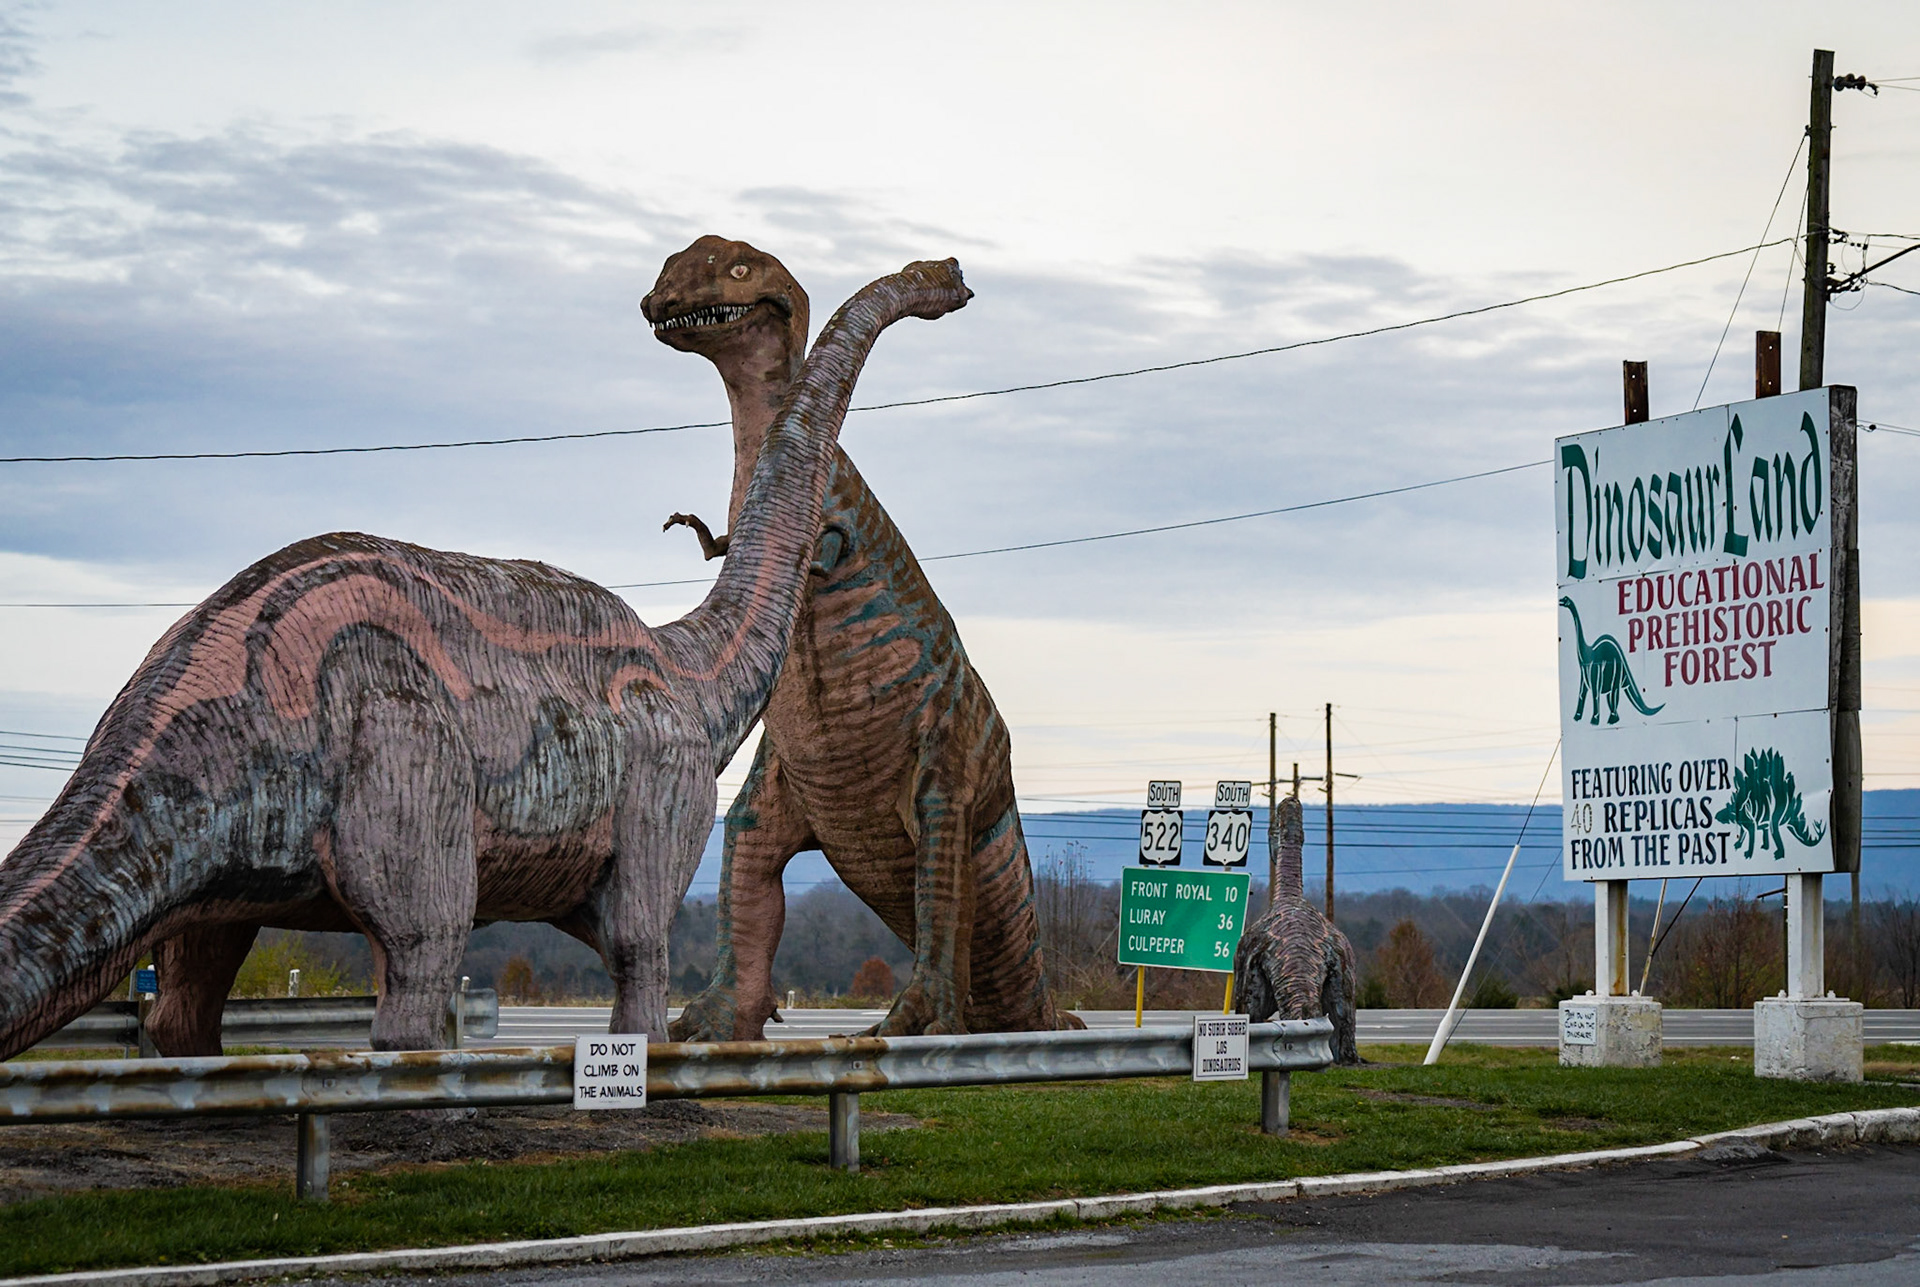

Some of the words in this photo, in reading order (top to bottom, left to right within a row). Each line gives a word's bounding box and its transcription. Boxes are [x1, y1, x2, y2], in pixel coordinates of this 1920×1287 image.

[1617, 552, 1825, 615] EDUCATIONAL
[1627, 595, 1812, 653] PREHISTORIC
[1664, 639, 1777, 687] FOREST
[1571, 762, 1672, 799] FEATURING
[1679, 758, 1731, 793] OVER
[1149, 784, 1179, 802] SOUTH
[1217, 784, 1249, 802] SOUTH
[1571, 802, 1593, 835] 40
[1603, 796, 1713, 833] REPLICAS
[1143, 822, 1179, 851] 522
[1207, 822, 1247, 853] 340
[1571, 836, 1625, 870] FROM
[1631, 833, 1671, 866] THE
[1678, 831, 1731, 865] PAST
[1131, 881, 1168, 898] FRONT
[1175, 883, 1213, 902] ROYAL
[1224, 886, 1238, 903] 10
[1129, 908, 1166, 925] LURAY
[1217, 913, 1233, 930] 36
[1128, 935, 1185, 954] CULPEPER
[1214, 941, 1230, 958] 56
[1198, 1023, 1206, 1036] NO
[1208, 1022, 1226, 1036] SUBIR
[1228, 1022, 1246, 1036] SOBRE
[590, 1043, 608, 1056] DO
[611, 1043, 636, 1056] NOT
[1216, 1040, 1227, 1054] LOS
[584, 1064, 619, 1077] CLIMB
[623, 1064, 639, 1077] ON
[1203, 1058, 1241, 1072] DINOSAURIOS
[579, 1086, 597, 1098] THE
[600, 1085, 643, 1098] ANIMALS
